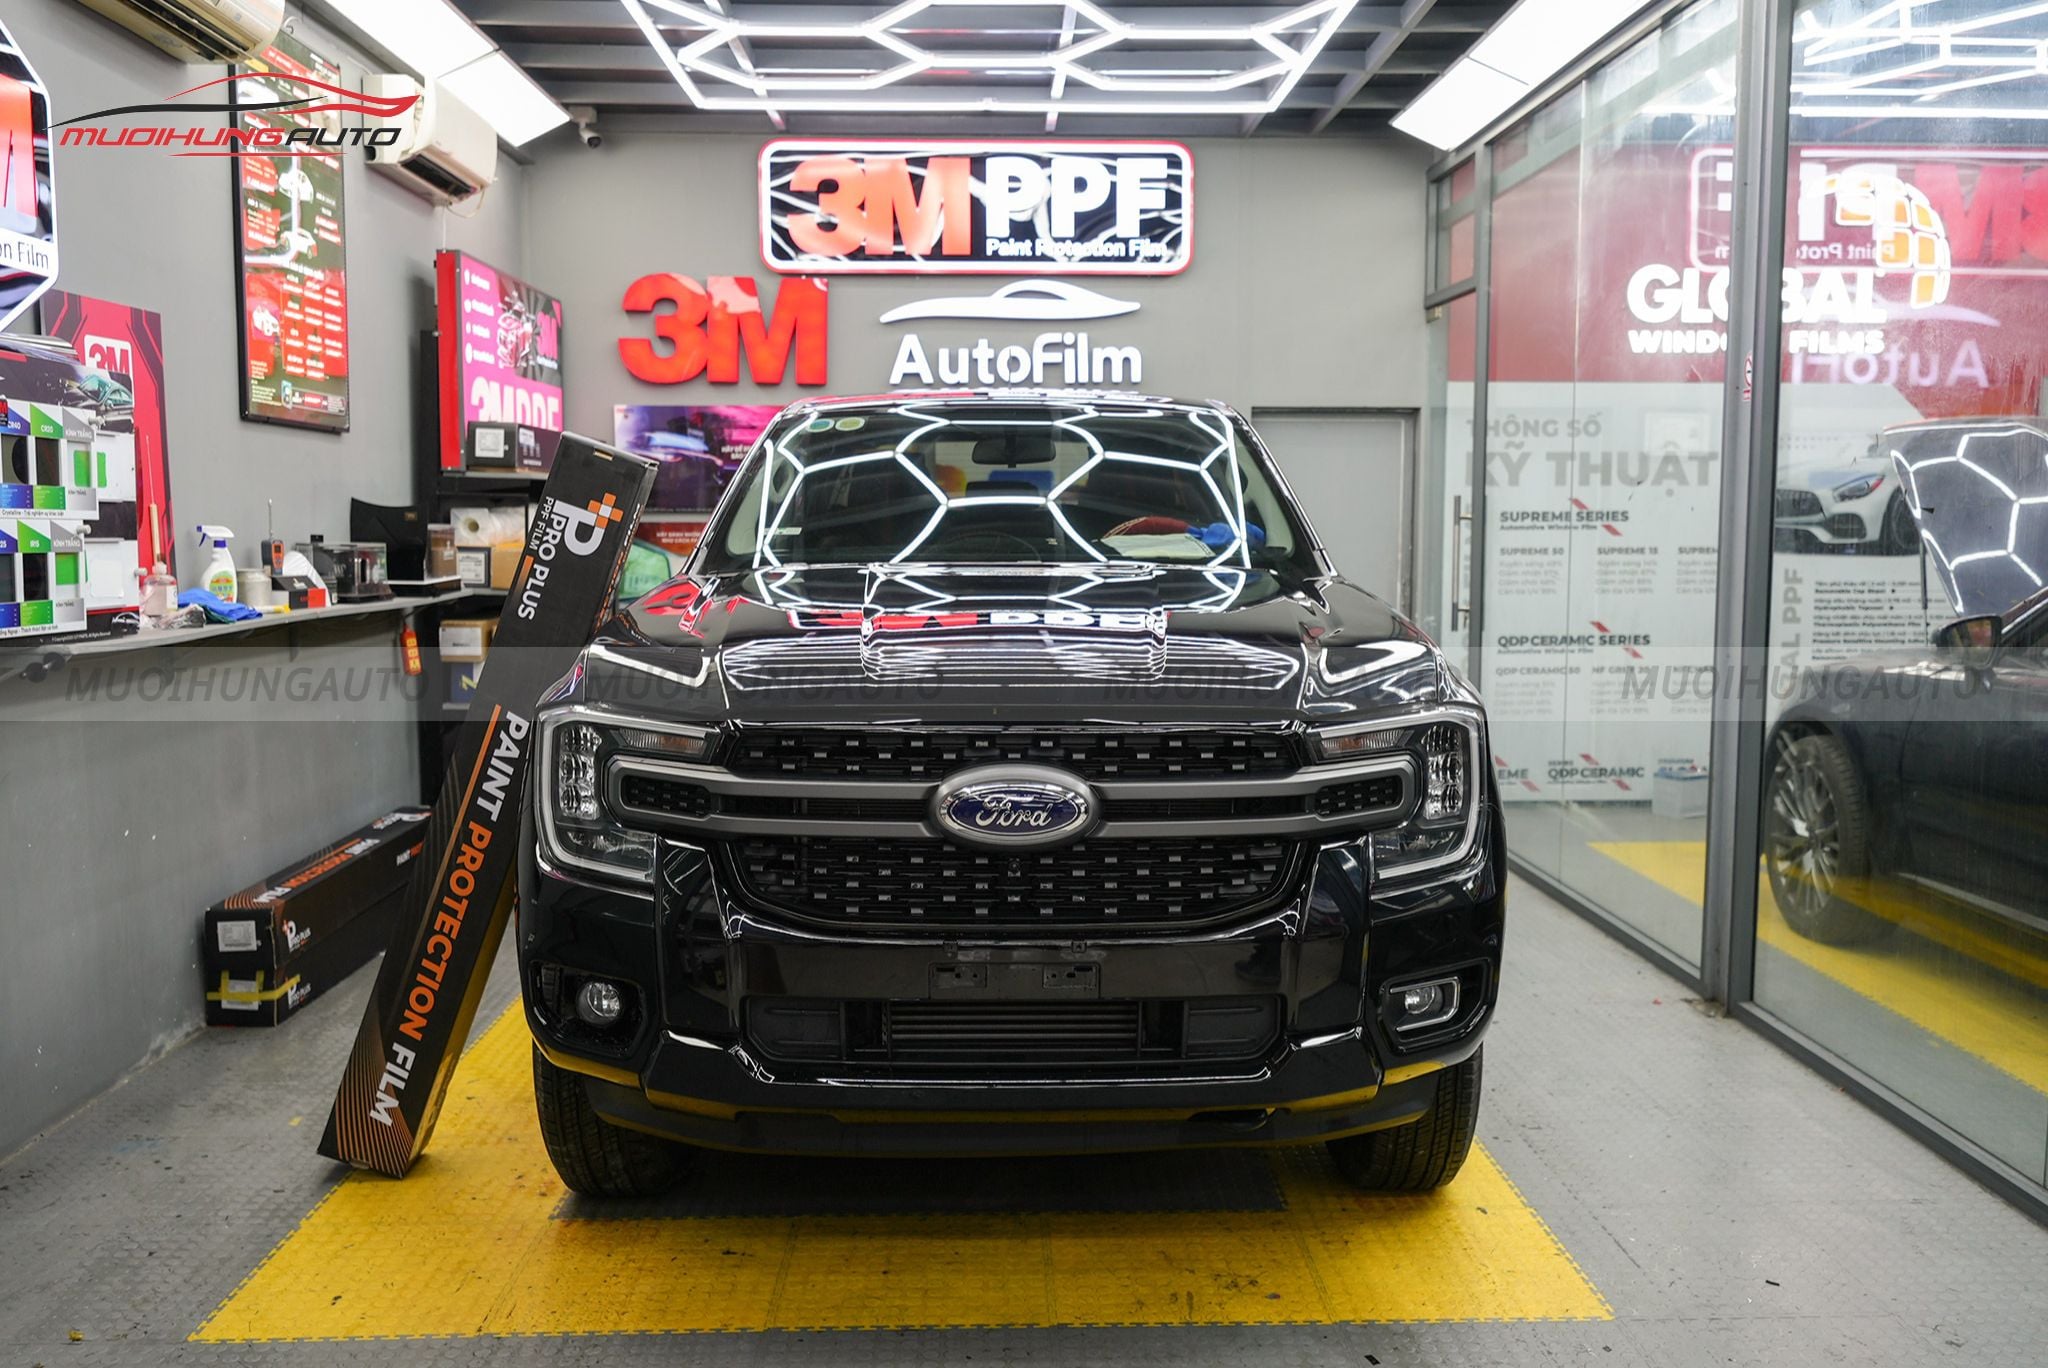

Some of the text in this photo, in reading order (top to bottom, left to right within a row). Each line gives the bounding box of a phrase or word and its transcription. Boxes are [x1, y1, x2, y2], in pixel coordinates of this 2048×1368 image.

[787, 155, 1168, 257] 3M PPF
[18, 241, 49, 270] Film
[986, 238, 1032, 256] Paint
[1035, 238, 1126, 257] Protection
[617, 271, 829, 386] 3M
[1788, 329, 1886, 355] FILMS
[888, 331, 1143, 386] AutoFilm
[529, 496, 555, 551] PPF FILM
[1500, 510, 1630, 522] SUPREME SERIES
[517, 513, 566, 620] PRO PLUS
[1498, 634, 1651, 648] QDP CERAMIC SERIES
[475, 711, 530, 822] PAINT
[1548, 768, 1579, 780] QDP
[1580, 767, 1645, 779] CERAMIC
[976, 794, 1054, 827] Ford
[398, 820, 493, 1041] PROTECTION
[370, 1042, 416, 1127] FILM
